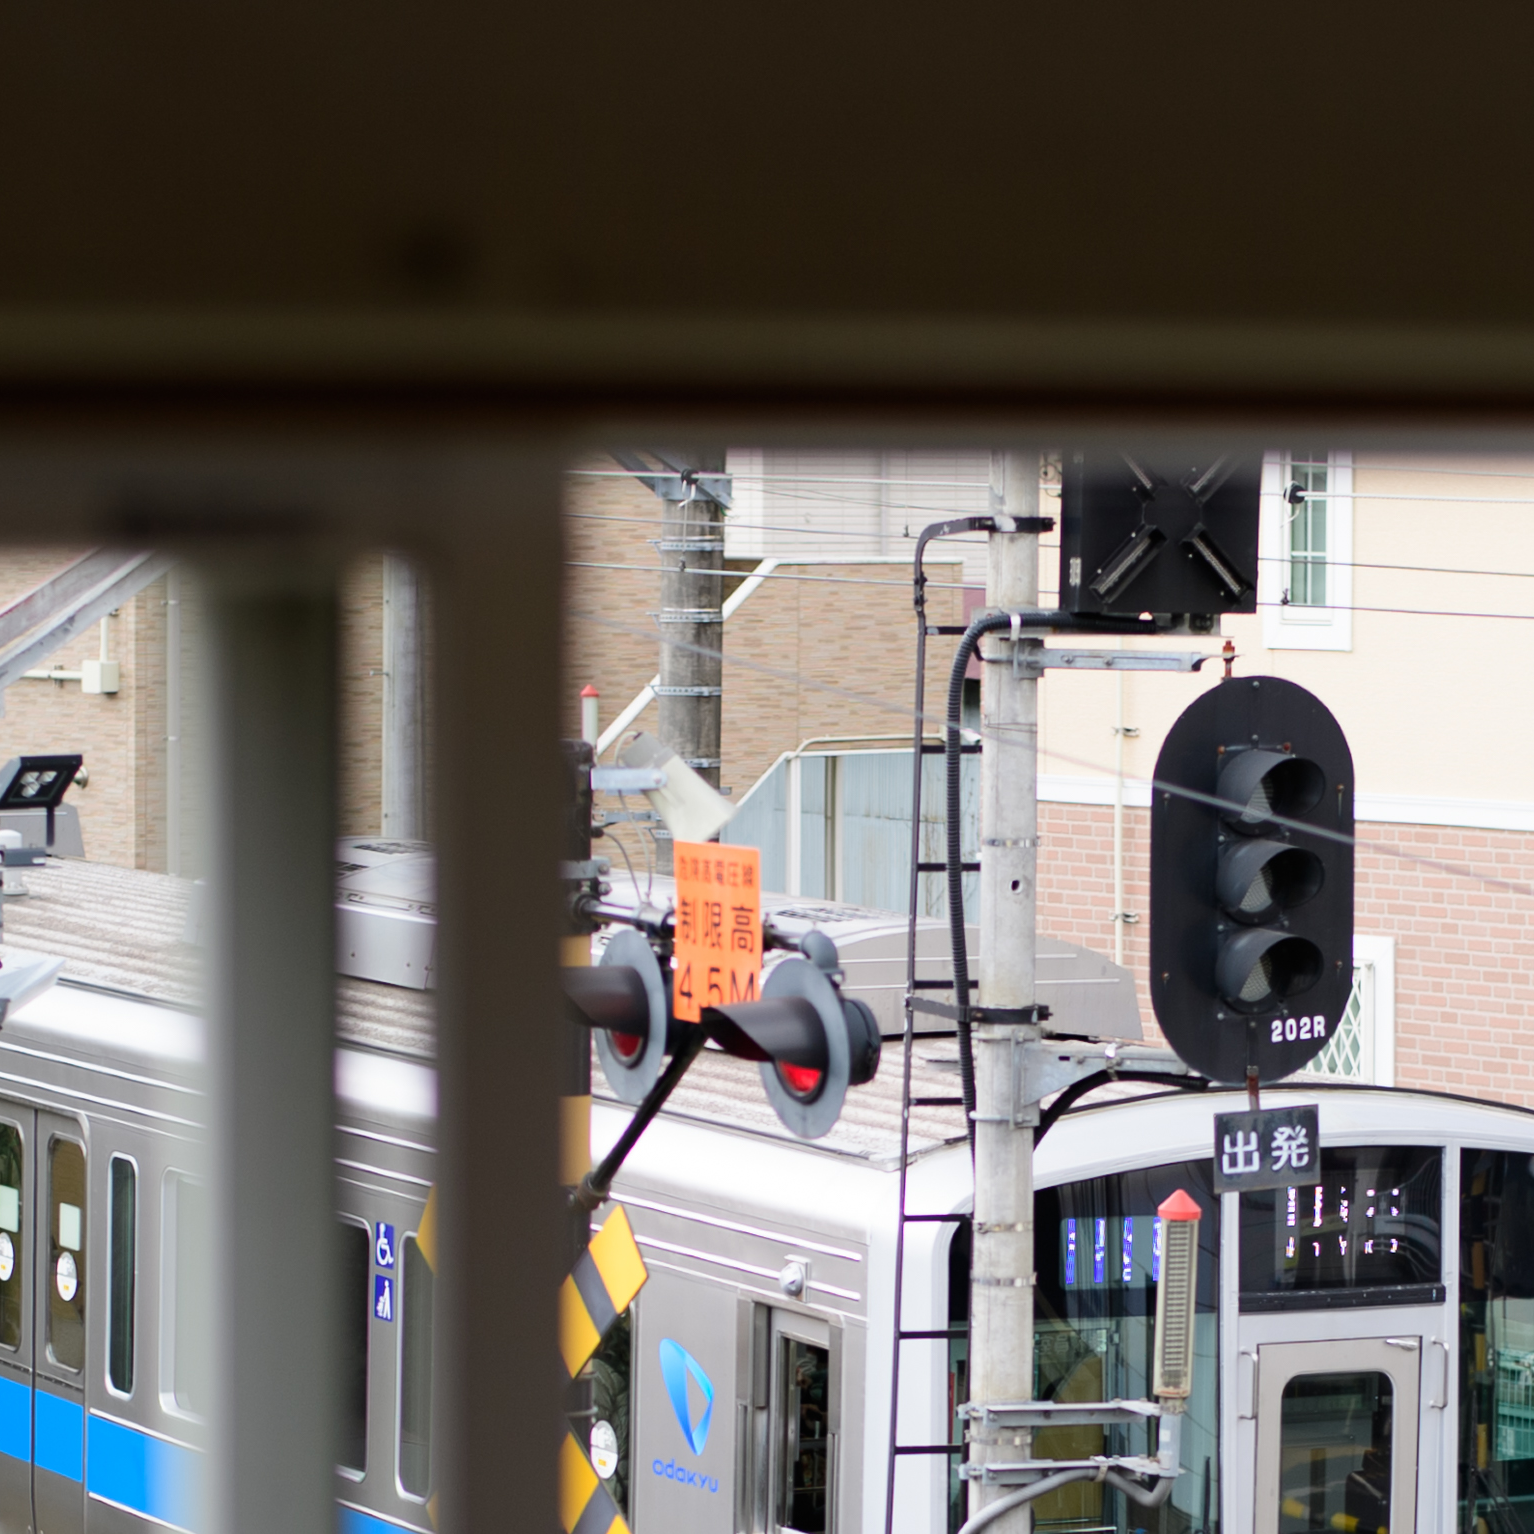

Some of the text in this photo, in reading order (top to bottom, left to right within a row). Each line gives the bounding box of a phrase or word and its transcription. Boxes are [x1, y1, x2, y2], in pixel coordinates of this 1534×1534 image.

[680, 897, 755, 955] 制限高
[679, 961, 755, 1010] 45M
[1270, 1014, 1326, 1044] 202R
[1221, 1124, 1310, 1175] 出発
[652, 1457, 719, 1493] odakyu
